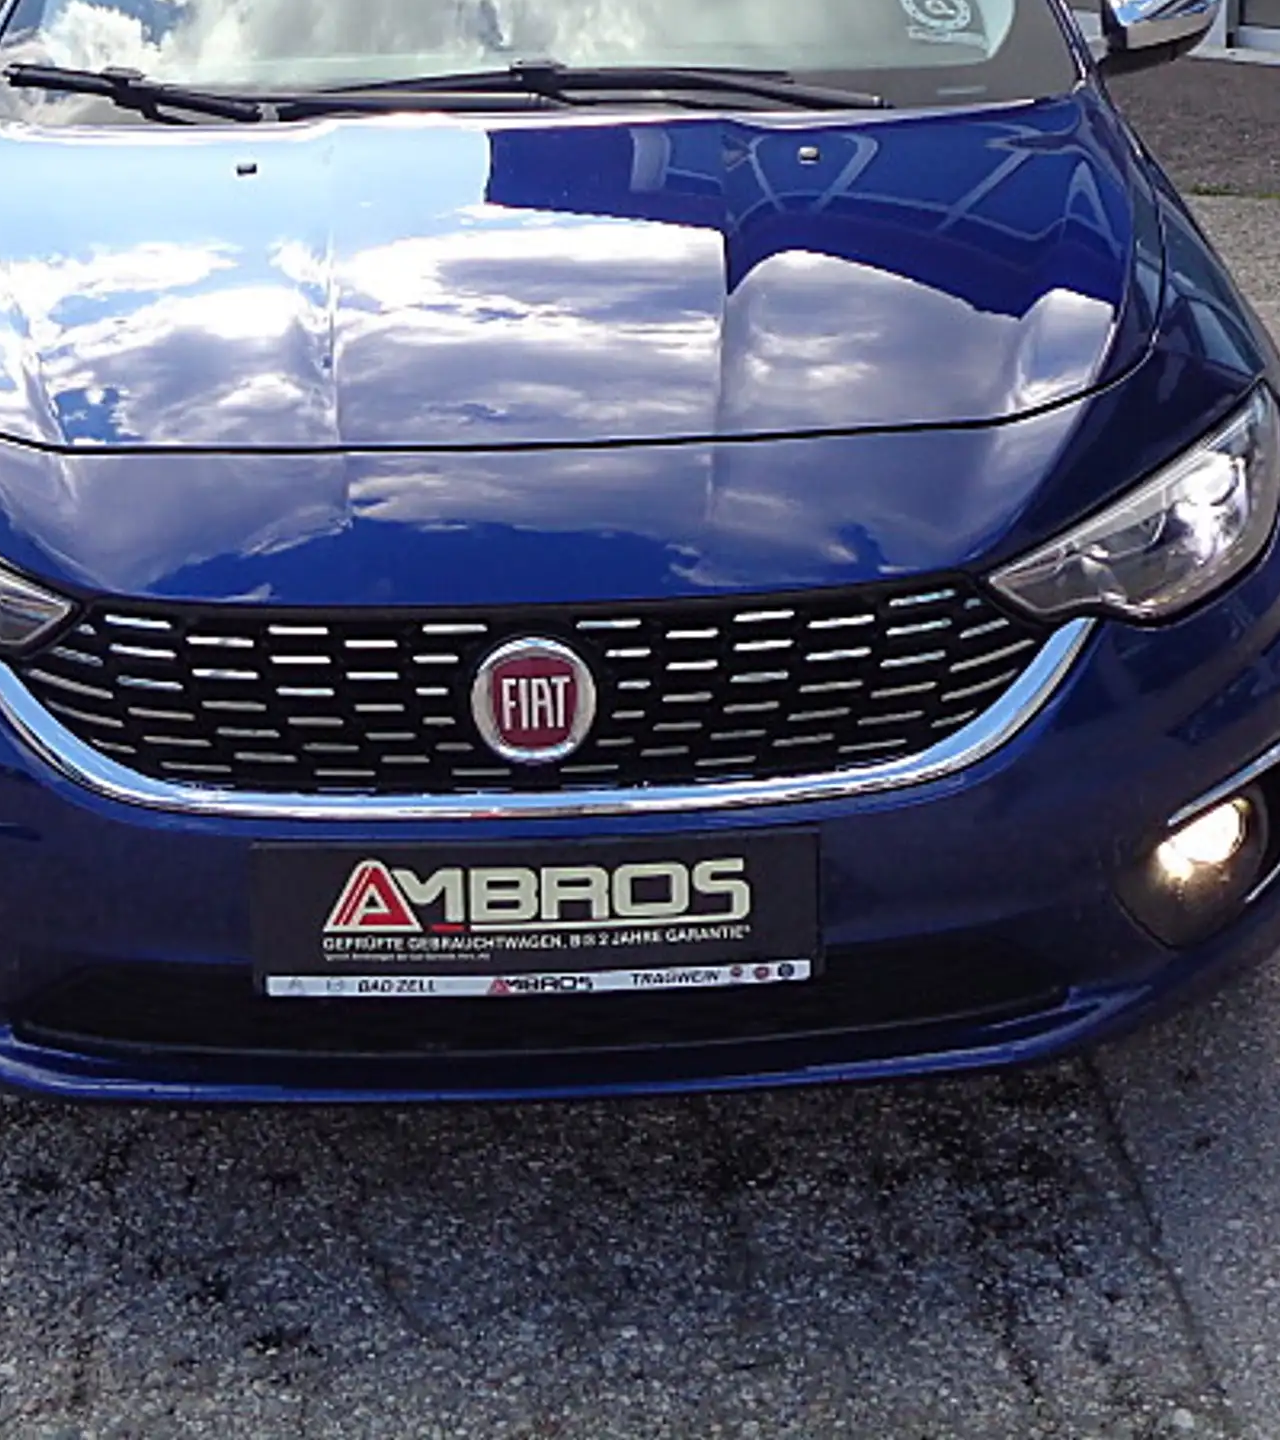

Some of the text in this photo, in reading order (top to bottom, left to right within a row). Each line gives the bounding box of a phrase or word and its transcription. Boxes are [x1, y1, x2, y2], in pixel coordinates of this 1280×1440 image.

[501, 675, 571, 730] FIAT
[323, 858, 751, 932] AMBROS
[323, 934, 404, 951] GEPRÜFTE
[358, 979, 392, 992] BAD
[396, 979, 437, 993] ZELL
